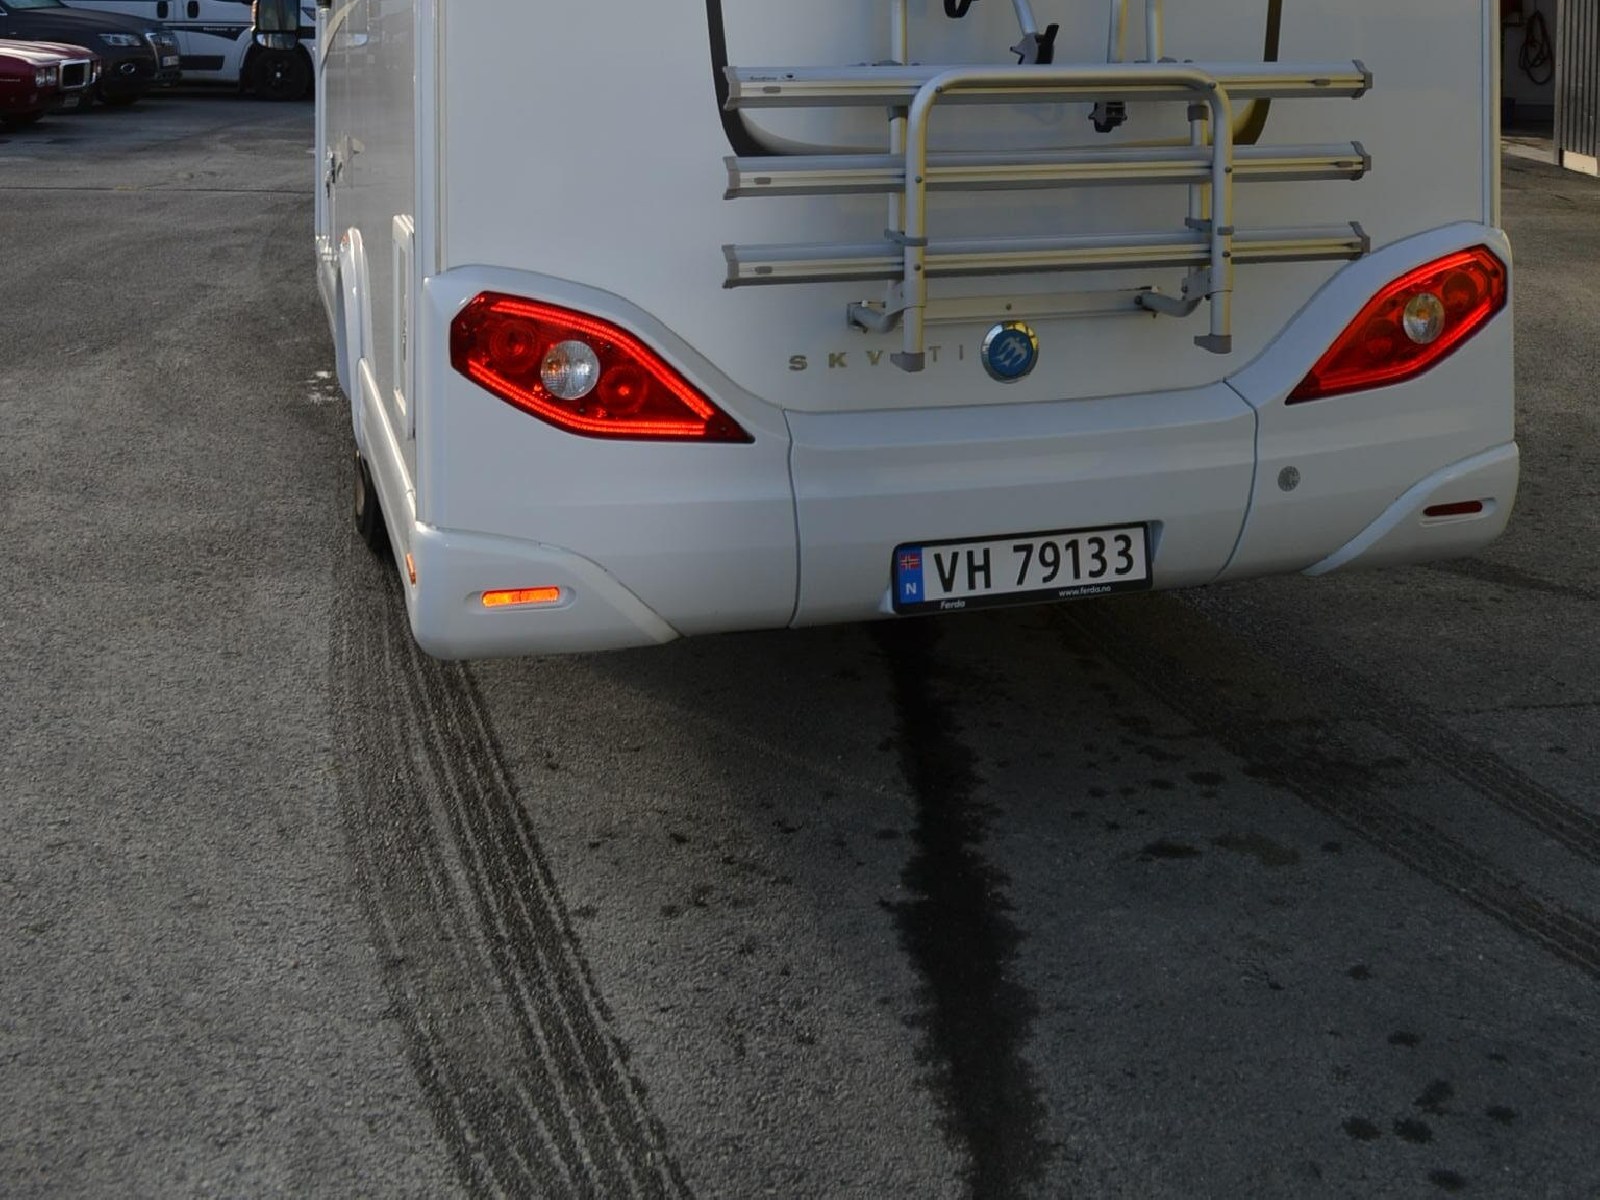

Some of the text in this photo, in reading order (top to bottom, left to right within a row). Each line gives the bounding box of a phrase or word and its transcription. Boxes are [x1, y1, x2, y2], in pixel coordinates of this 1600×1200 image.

[905, 534, 1135, 595] N VH 79133
